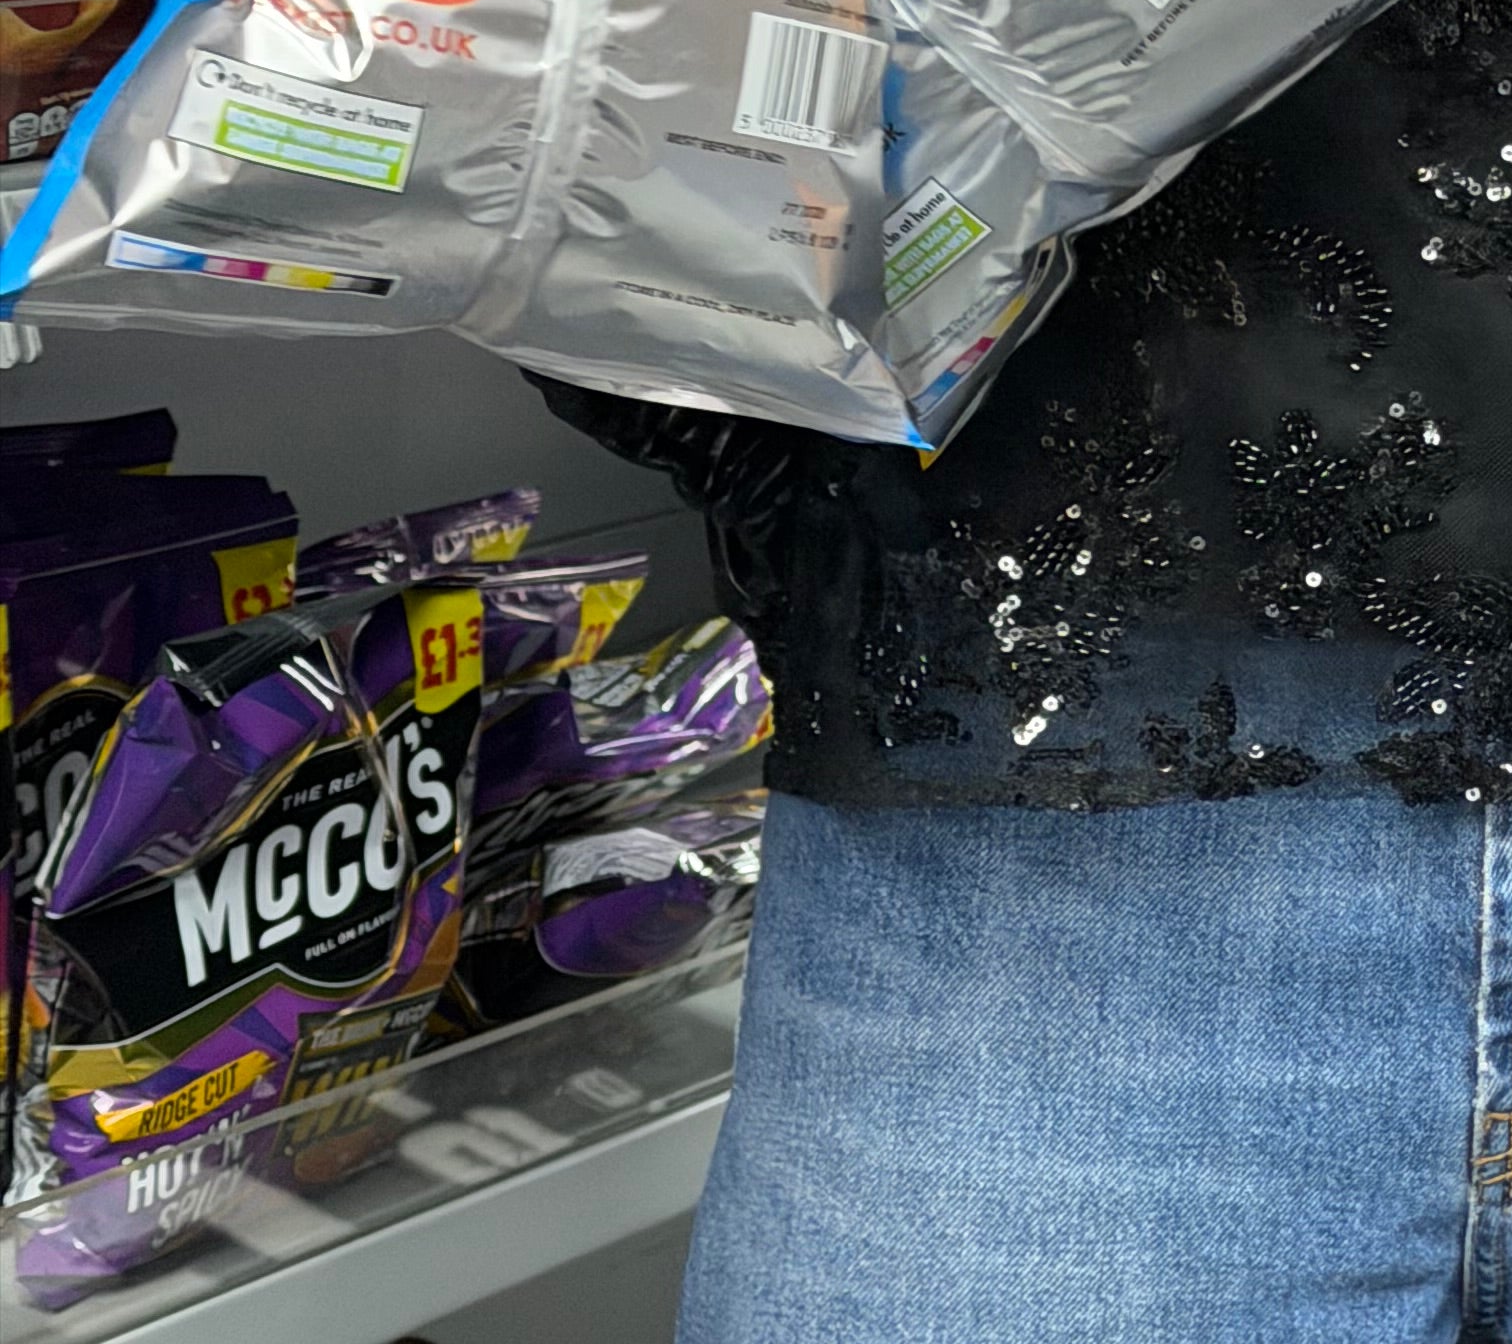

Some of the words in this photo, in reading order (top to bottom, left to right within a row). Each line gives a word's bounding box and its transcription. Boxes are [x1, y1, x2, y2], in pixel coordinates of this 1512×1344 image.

[912, 190, 947, 229] home
[420, 617, 481, 690] £1.3
[49, 708, 97, 747] REAL
[282, 784, 323, 812] THE
[328, 766, 376, 796] REA
[305, 938, 337, 961] FULL
[138, 1091, 199, 1135] RIDGE
[204, 1063, 240, 1107] CUT
